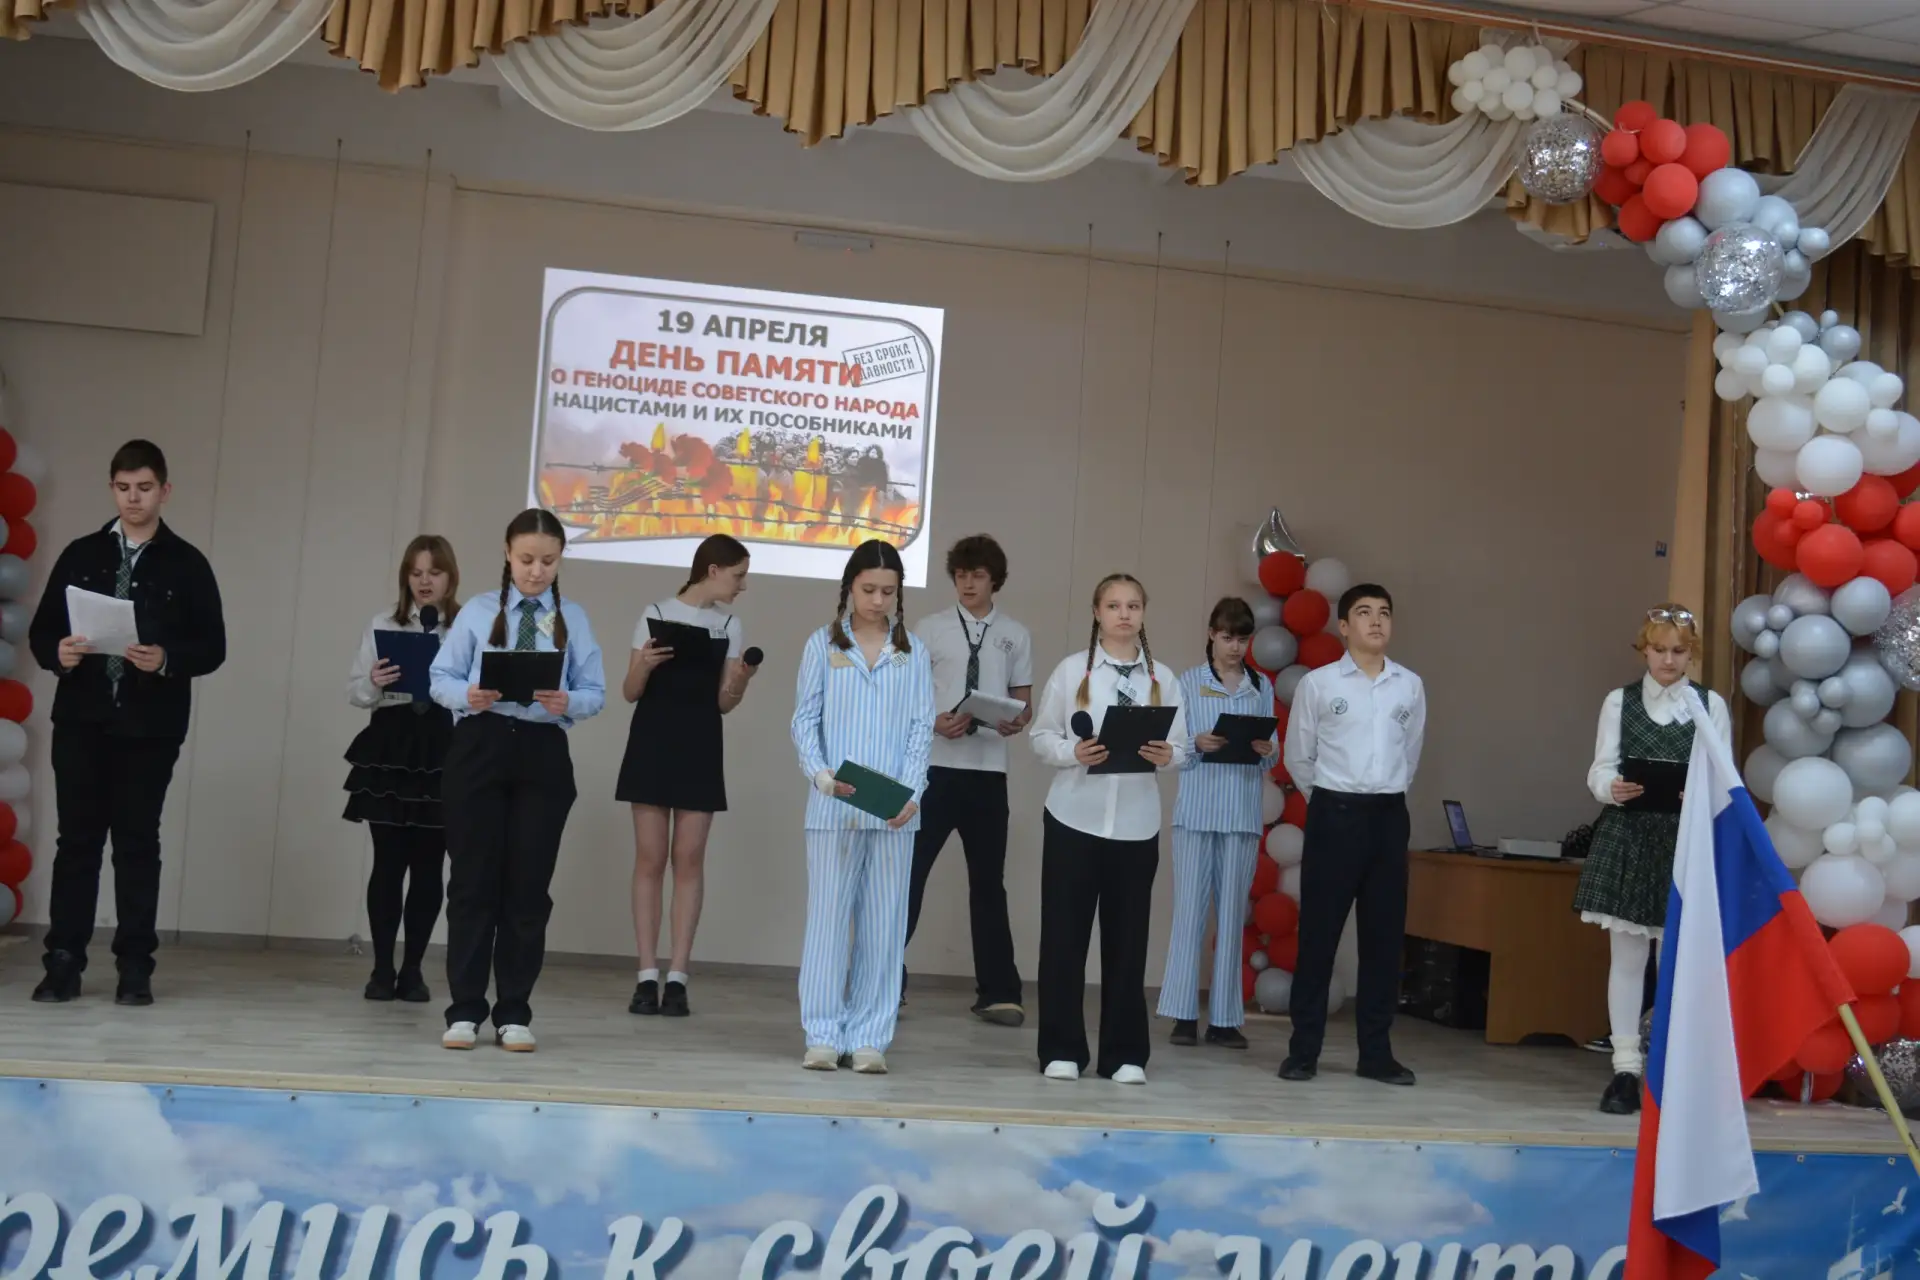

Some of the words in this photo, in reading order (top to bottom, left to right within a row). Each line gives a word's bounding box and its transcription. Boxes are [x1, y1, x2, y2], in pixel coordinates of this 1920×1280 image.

[657, 309, 694, 334] 19
[702, 314, 828, 348] АПРЕЛЯ
[609, 339, 705, 372] ДЕНЬ
[716, 350, 863, 388] ПАМЯТИ
[853, 351, 873, 365] БЕЗ
[875, 342, 911, 361] СРОКА
[551, 368, 567, 385] О
[573, 369, 687, 398] ГЕНОЦИДЕ
[692, 381, 829, 409] СОВЕТСКОГО
[835, 395, 919, 421] НАРОДА
[553, 391, 686, 419] НАЦИСТАМИ
[692, 404, 708, 421] И
[714, 406, 743, 424] ИХ
[750, 409, 912, 441] ПОСОБНИКАМИ
